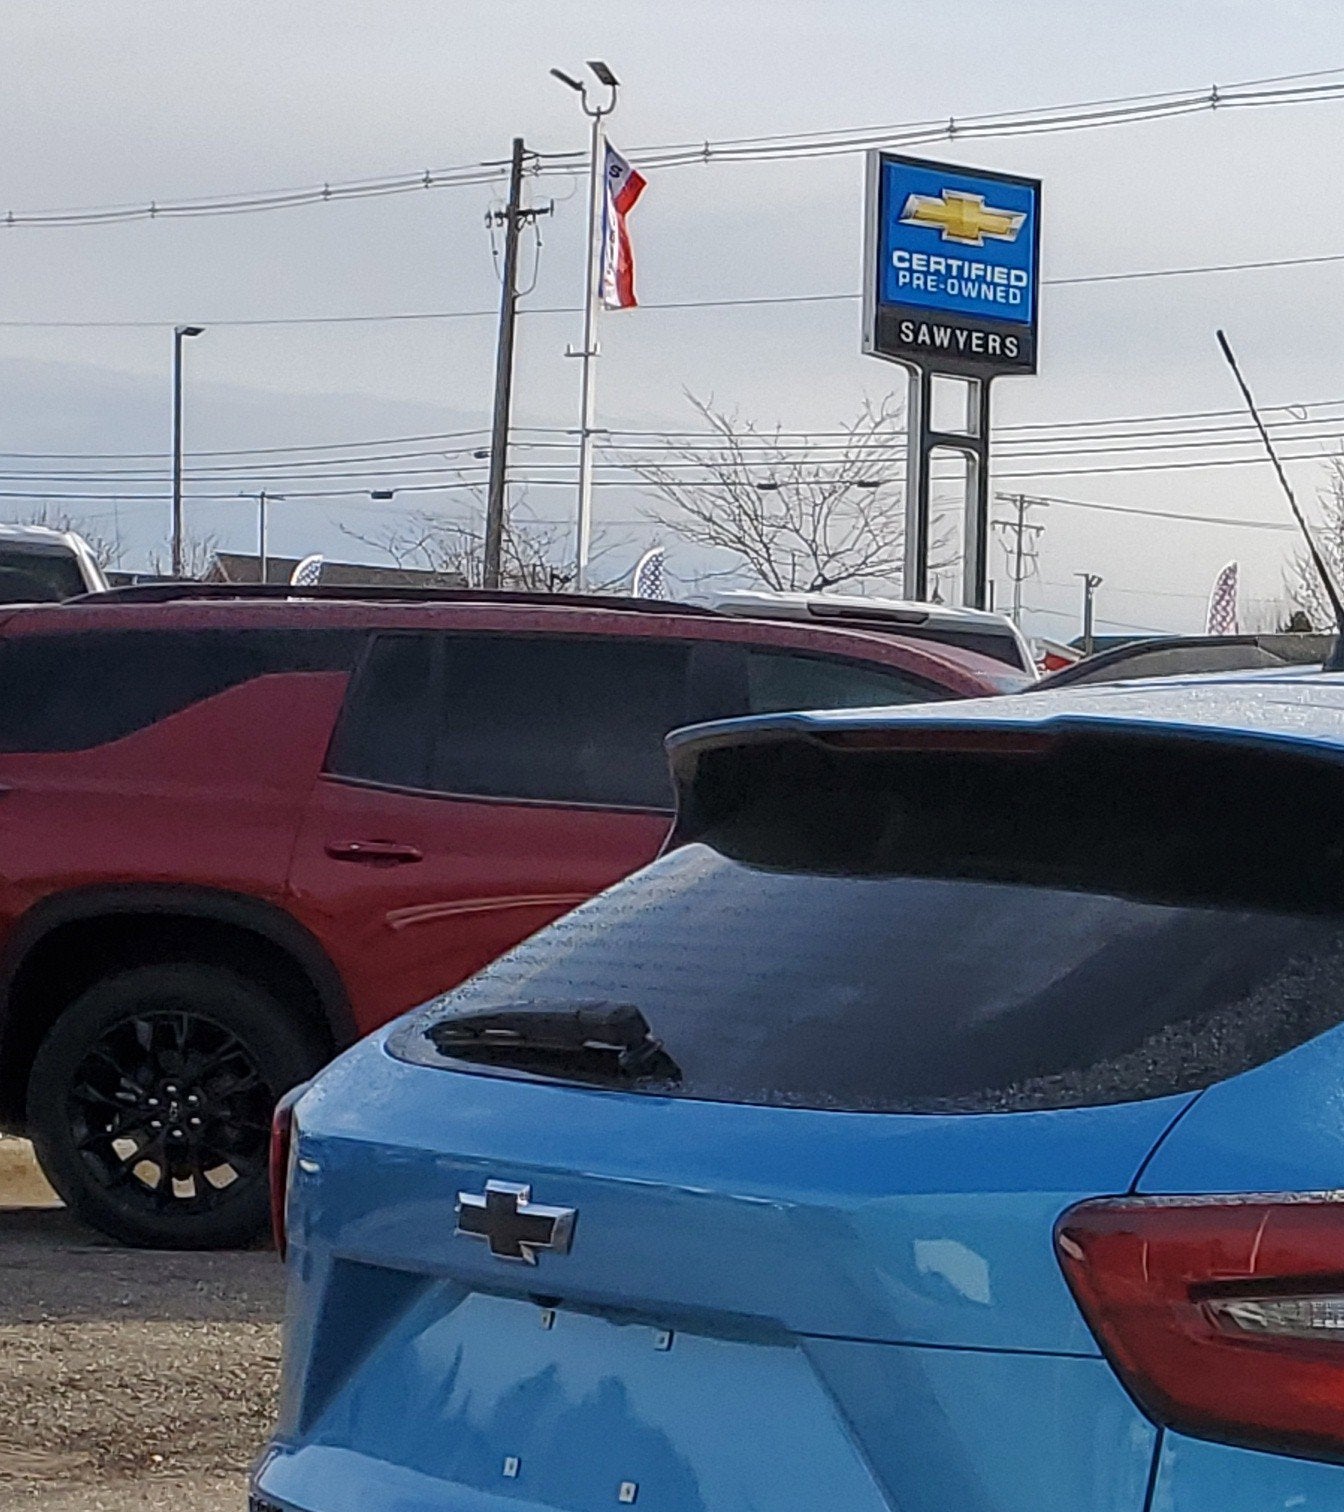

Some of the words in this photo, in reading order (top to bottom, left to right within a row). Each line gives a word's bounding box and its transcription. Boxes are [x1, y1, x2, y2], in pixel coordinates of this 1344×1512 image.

[892, 250, 1028, 287] CERTIFIED
[898, 271, 1021, 304] PRE-OWNED
[900, 321, 1019, 358] SAWYERS
